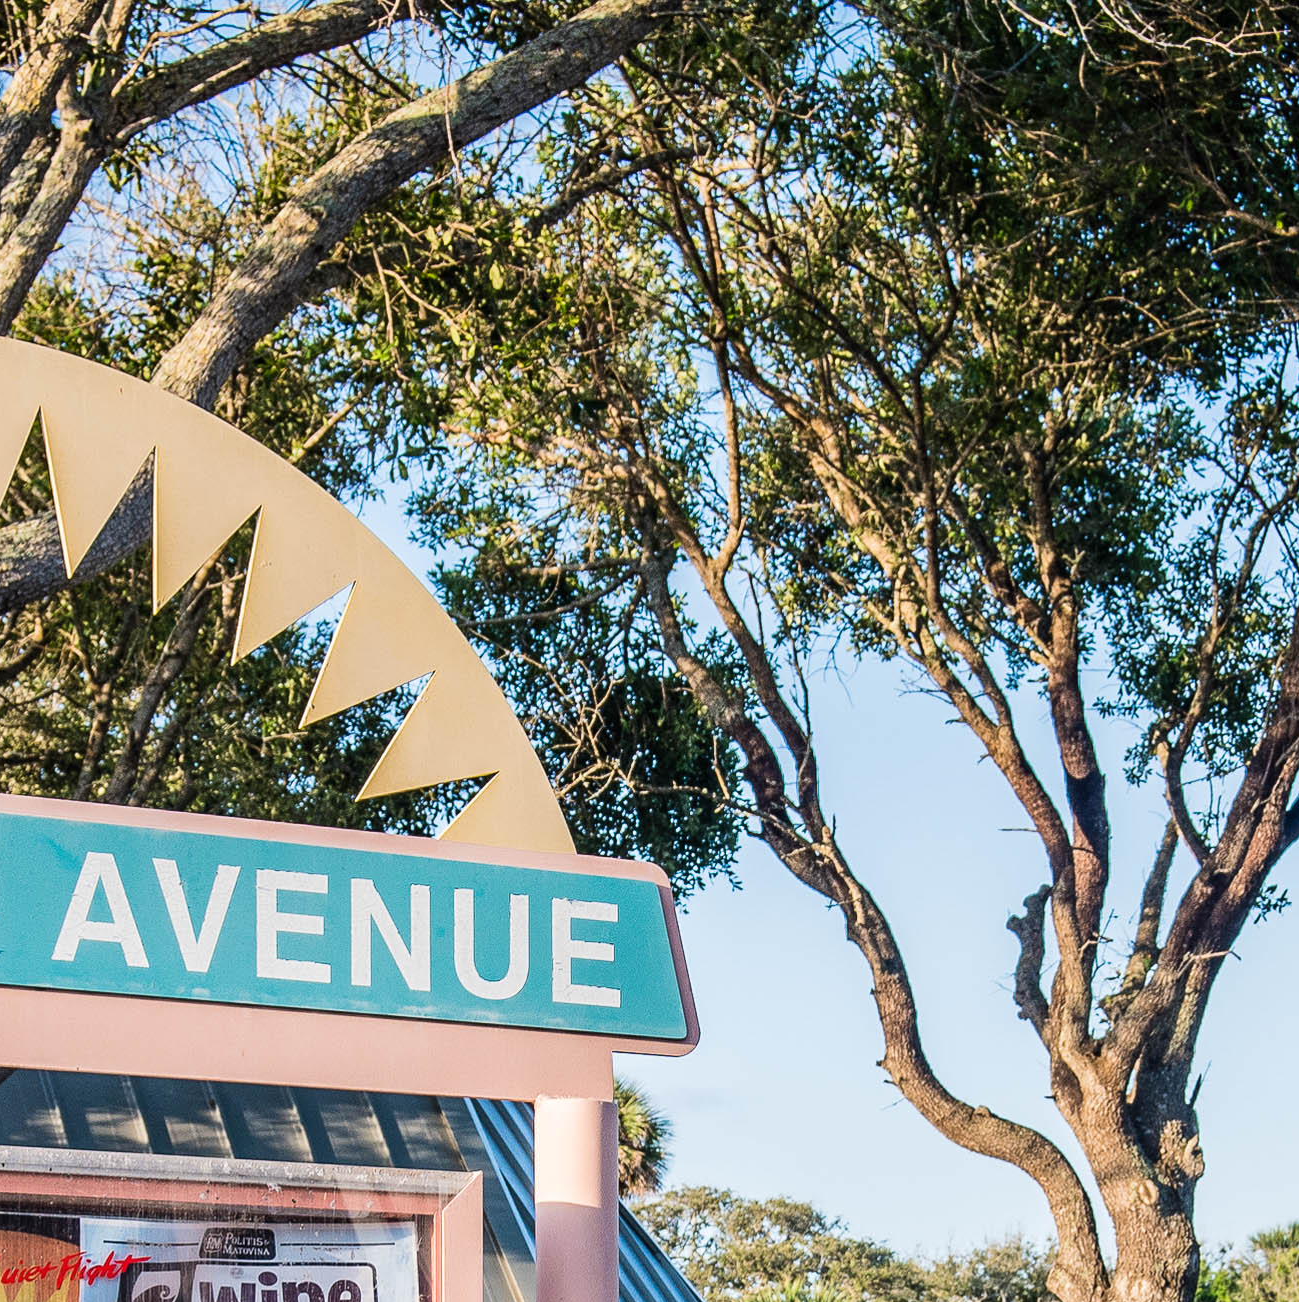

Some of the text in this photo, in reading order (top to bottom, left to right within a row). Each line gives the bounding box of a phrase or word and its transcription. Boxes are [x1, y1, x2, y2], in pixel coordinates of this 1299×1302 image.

[51, 850, 622, 1009] AVENUE
[222, 1246, 270, 1255] MATOVINA
[224, 1234, 263, 1246] POLITIS
[55, 1252, 150, 1290] Flight
